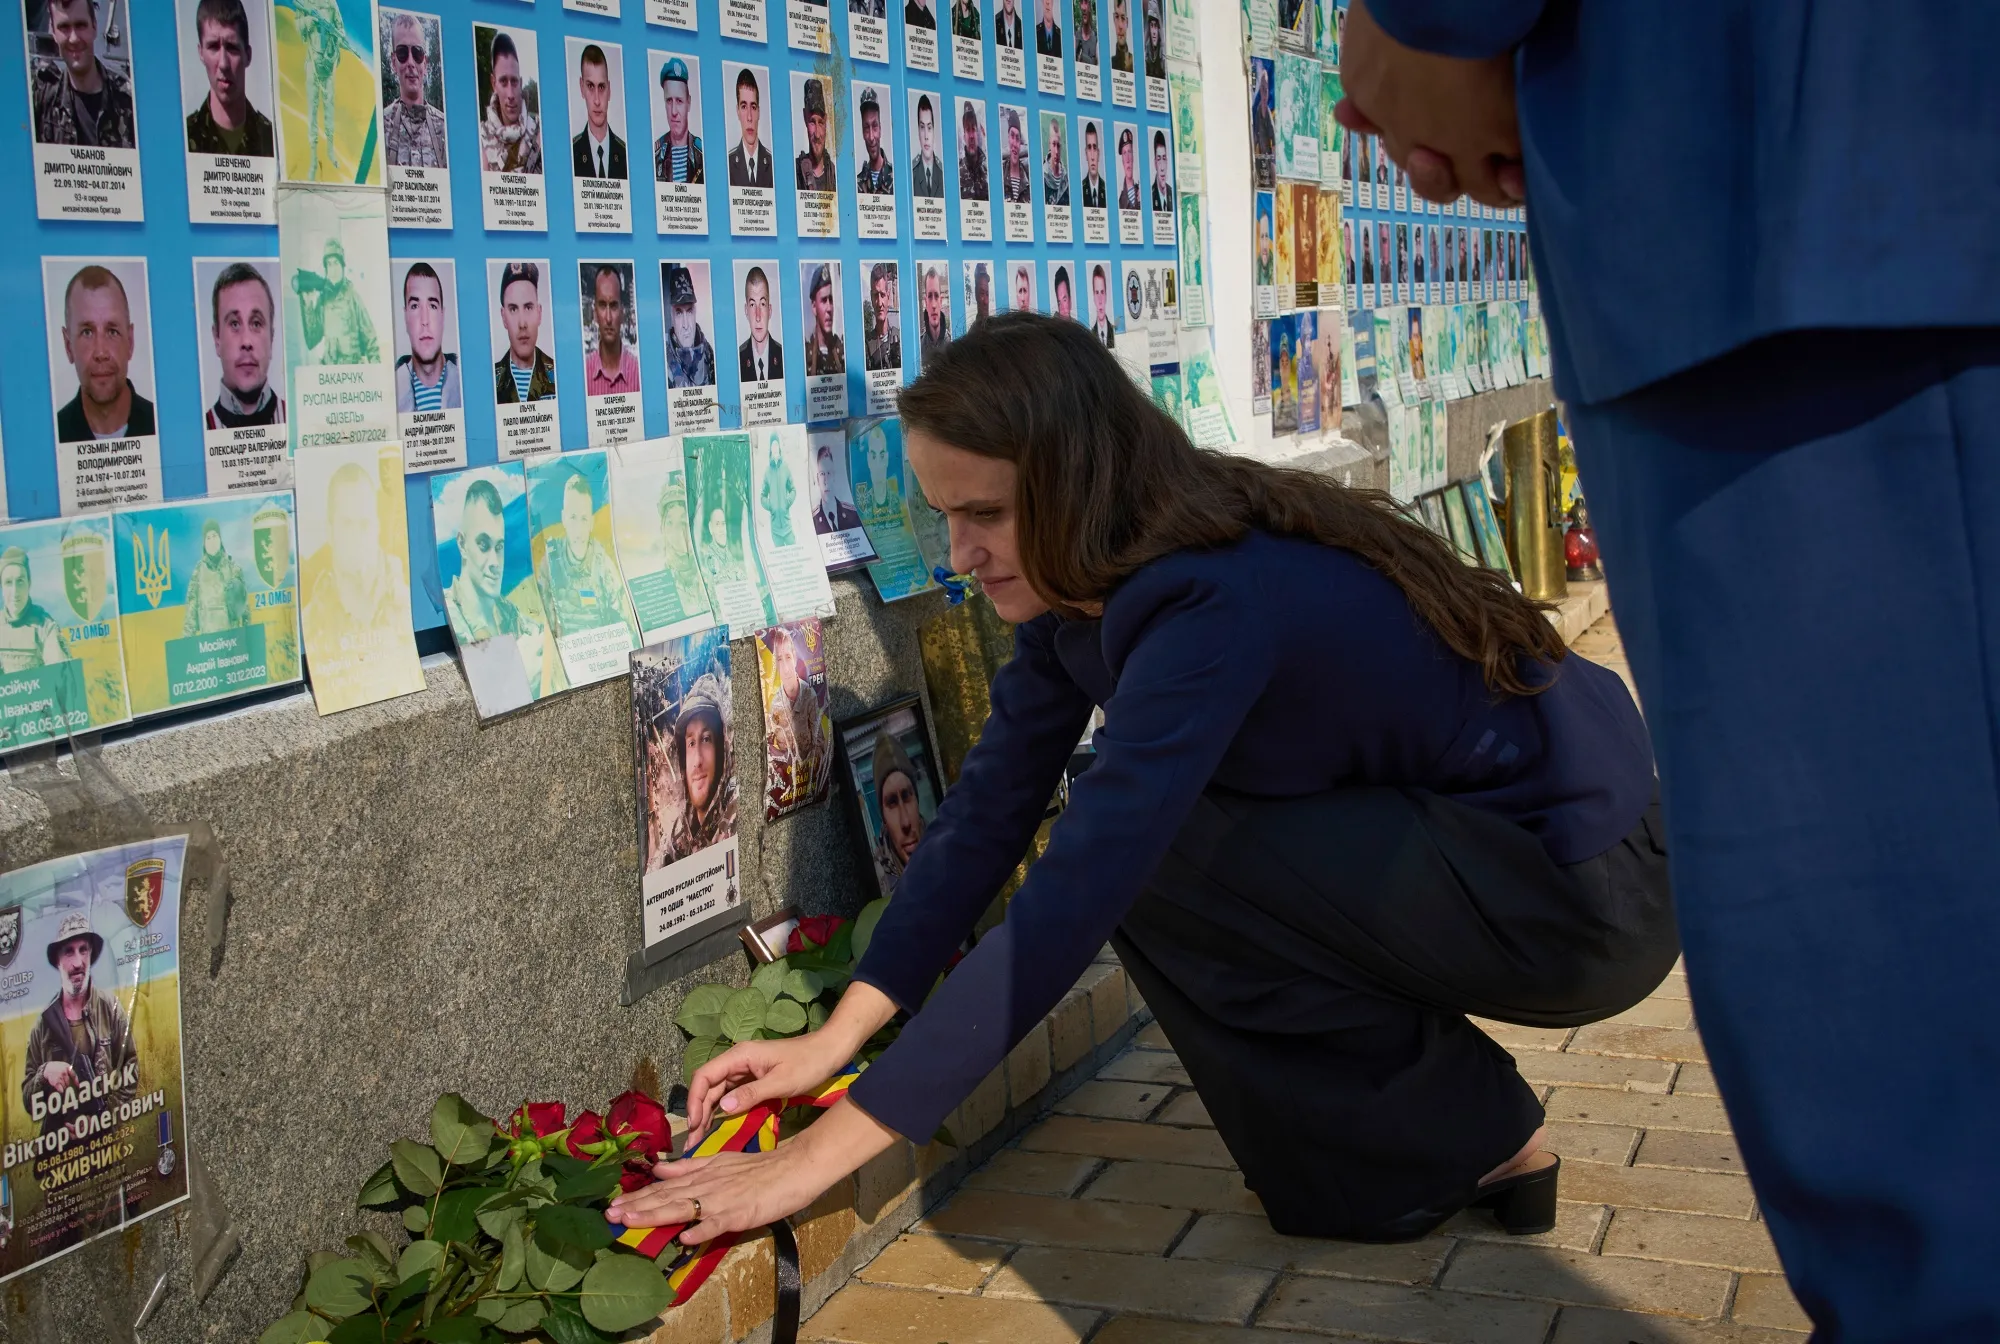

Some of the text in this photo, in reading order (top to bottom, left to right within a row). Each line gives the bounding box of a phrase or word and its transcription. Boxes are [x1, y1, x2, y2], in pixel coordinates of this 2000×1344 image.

[71, 149, 106, 161] ЧАБАНОВ
[44, 162, 133, 177] ДМИТРО АНАТОЛІЙОВИЧ
[215, 157, 251, 169] ШЕВЧЕНКО
[204, 171, 264, 184] ДМИТРО ІВАНОВИЧ
[404, 169, 425, 179] ЧЕРНЯК
[501, 174, 527, 185] ЧУБАТЕНКО
[404, 182, 438, 193] ВАСИЛЬОВИЧ
[489, 186, 540, 197] РУСЛАН ВАЛЕРІЙОВИЧ
[675, 184, 687, 193] БОЙКО
[89, 195, 108, 204] окрема
[581, 190, 624, 201] СЕРГІЙ МИХАЙЛОВИЧ
[62, 205, 121, 216] механізована бригада
[233, 200, 250, 209] окрема
[210, 209, 261, 219] механізована бригада
[318, 371, 364, 385] ВАКАРЧУК
[303, 390, 383, 406] РУСЛАН ІВАНОВИЧ
[595, 404, 636, 416] ТАРАС ВАЛЕРІЙОВИЧ
[325, 411, 364, 426] «ДІЗЕЛЬ»
[413, 412, 446, 424] ВАСИЛИШИН
[503, 413, 553, 426] ПАВЛО МИКОЛАЙОВИЧ
[233, 428, 266, 440] ЯКУБЕНКО
[404, 423, 456, 437] АНДРІЙ ДМИТРОВИЧ
[77, 439, 141, 455] КУЗЬМІН ДМИТРО
[209, 439, 287, 457] ОЛЕКСАНДР ВАЛЕРІЙОВИ
[77, 454, 143, 471] ВОЛОДИМИРОВИЧ
[250, 468, 266, 478] окрема
[86, 485, 113, 496] батальйон
[114, 481, 148, 494] спеціального
[227, 477, 277, 490] механізована бригада
[77, 496, 112, 509] призначення
[255, 590, 292, 609] 24 ОМБр
[70, 624, 110, 643] 24 ОМБр
[199, 637, 238, 655] Мосійчук
[186, 653, 249, 678] Андрій Іванович
[0, 679, 40, 698] осійчук
[173, 666, 266, 697] 07.12.2000 30.12.2023
[5, 698, 53, 718] Іванович
[646, 863, 725, 907] АКТЕМІРОВ РУСЛАН СЕРГІЙОВИЧ
[659, 898, 715, 932] 24.08.1992 05.10.2022
[660, 907, 667, 917] 79
[668, 901, 684, 914] ОДШБ
[3, 1089, 164, 1169] Віктор Олегович
[37, 1125, 135, 1173] 05.08.1980 04.06.2024
[39, 1143, 134, 1192] «ЖИВЧИК»
